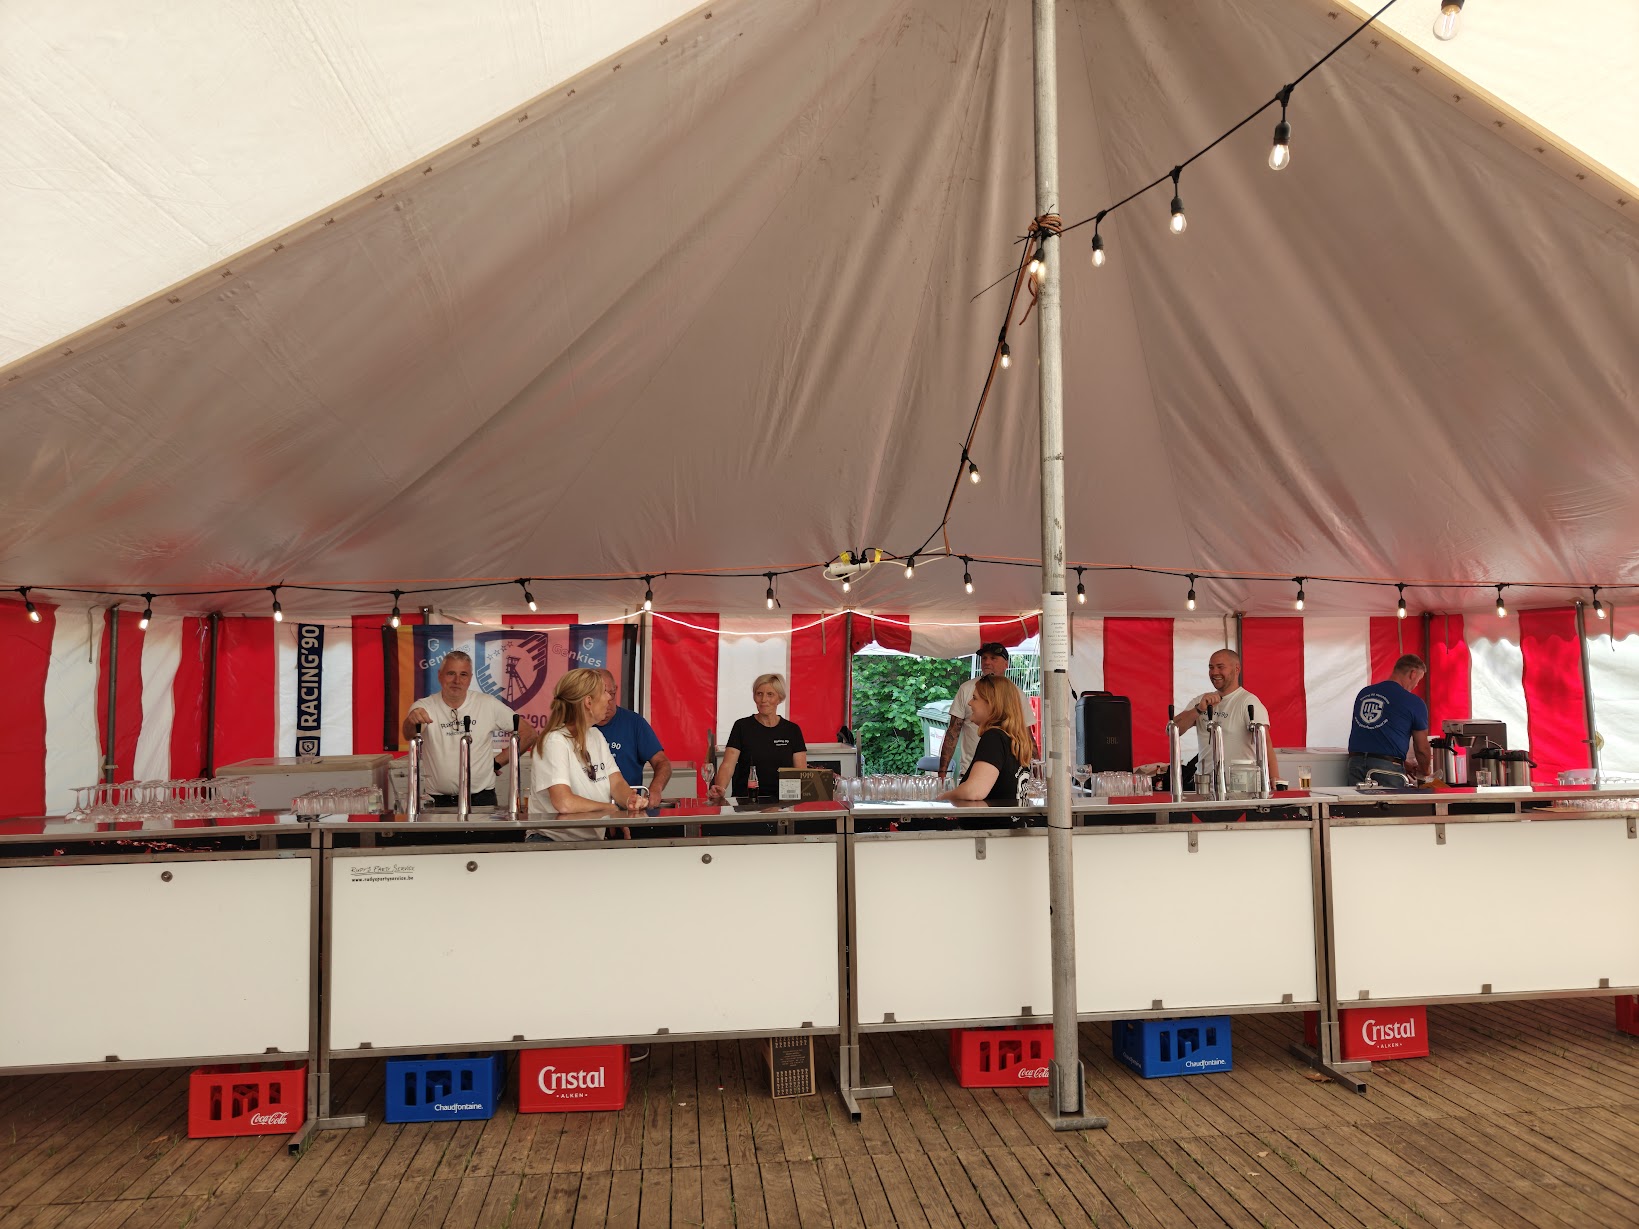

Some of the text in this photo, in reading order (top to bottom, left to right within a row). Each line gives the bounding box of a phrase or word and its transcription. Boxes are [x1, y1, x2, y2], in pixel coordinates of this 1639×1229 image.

[552, 643, 602, 668] Genkies
[300, 625, 320, 727] RACING'90
[1106, 736, 1119, 745] JBL
[799, 771, 815, 779] 1919
[1362, 1017, 1416, 1046] Cristal
[538, 1065, 606, 1095] Cristal
[250, 1111, 289, 1126] Coca-Cola
